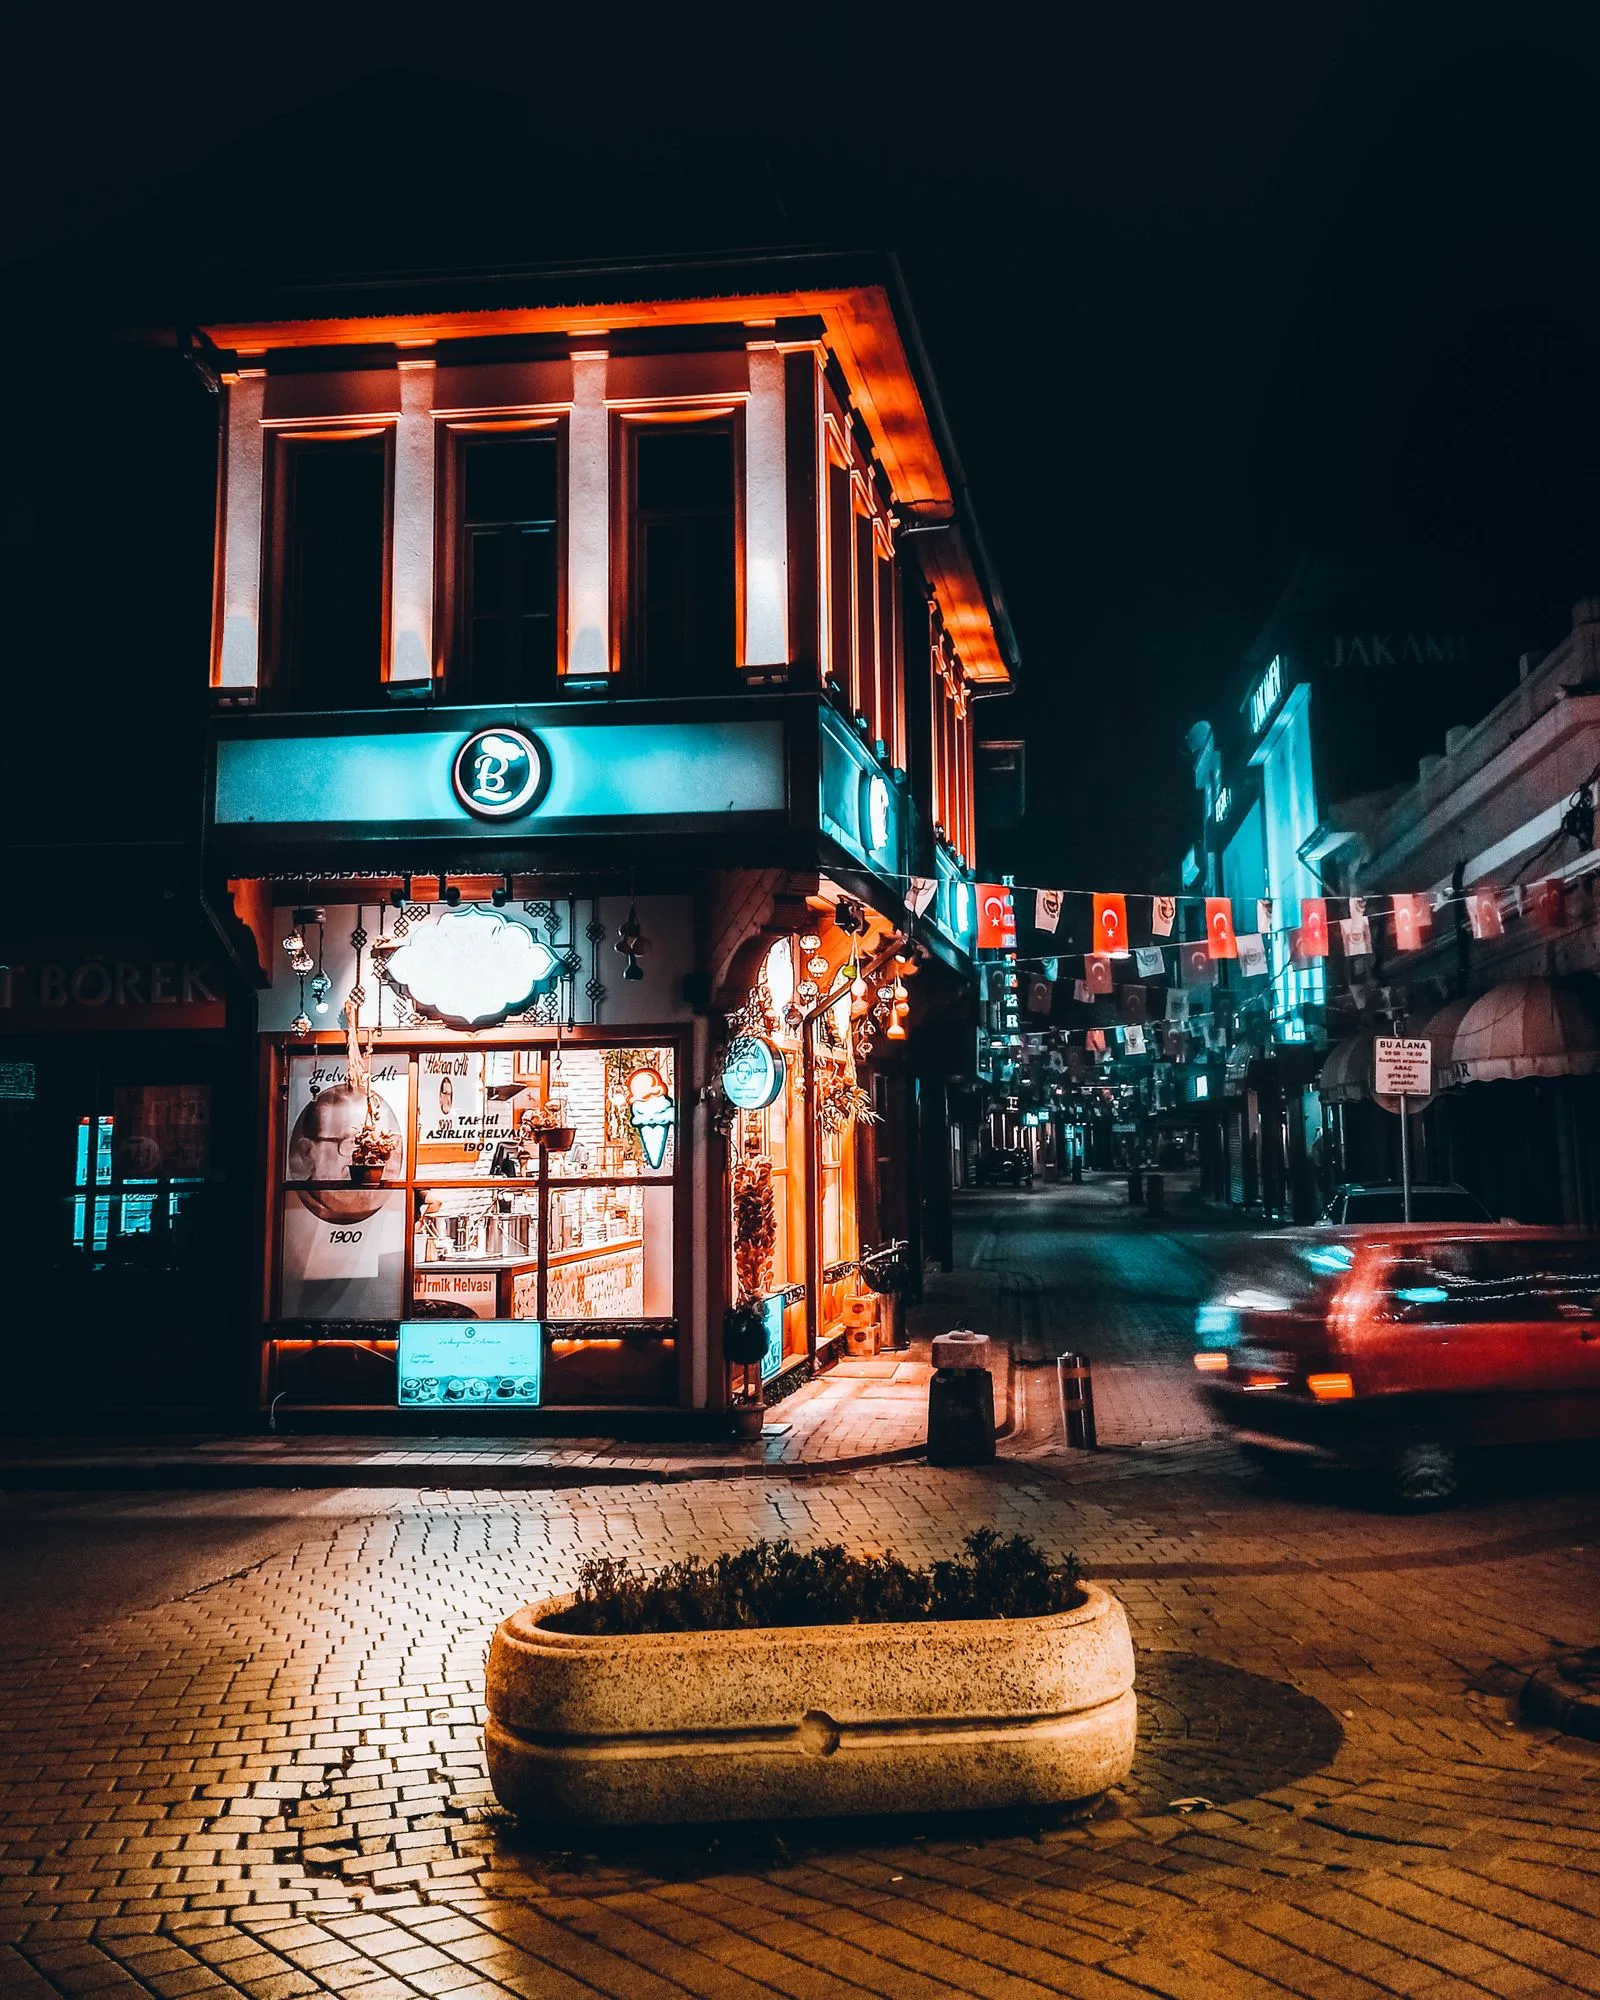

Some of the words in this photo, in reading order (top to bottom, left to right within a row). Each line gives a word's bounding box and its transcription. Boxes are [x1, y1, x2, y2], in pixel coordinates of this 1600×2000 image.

[42, 953, 218, 1007] BÖREK
[1380, 1041, 1393, 1049] BU
[1395, 1041, 1427, 1050] ALANA
[371, 1065, 397, 1082] Ali
[463, 1142, 494, 1152] 1900
[329, 1230, 363, 1244] 1900
[453, 1277, 492, 1293] Helvası
